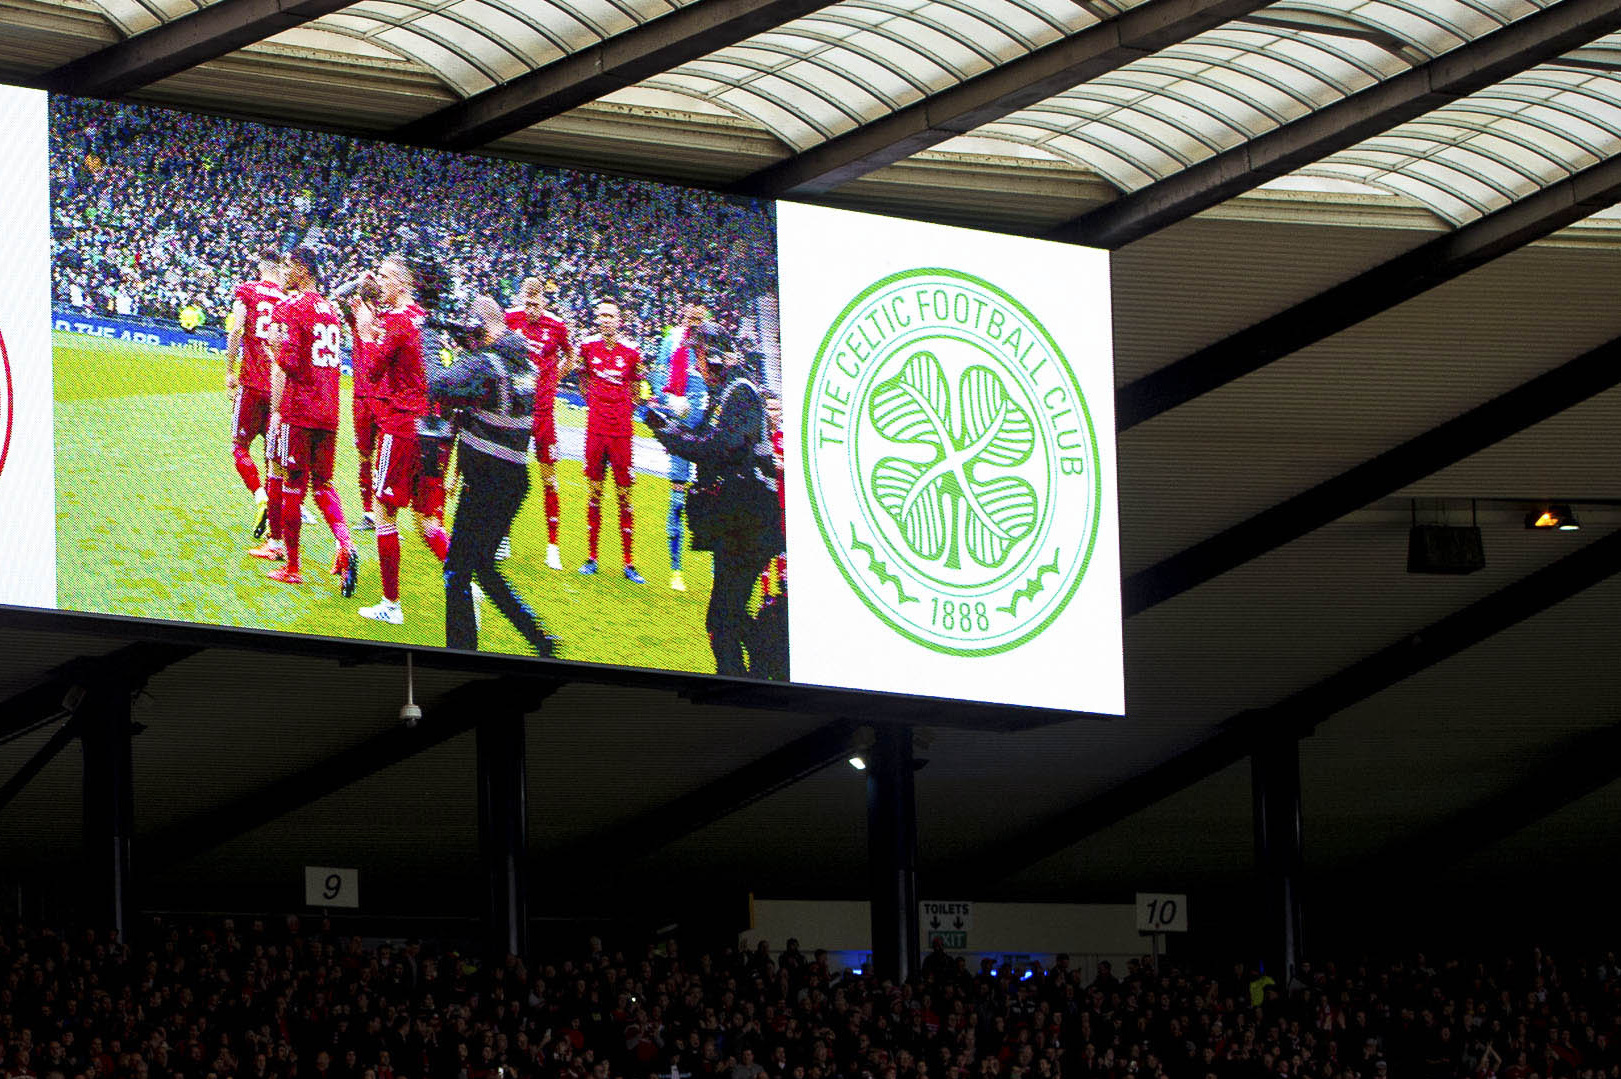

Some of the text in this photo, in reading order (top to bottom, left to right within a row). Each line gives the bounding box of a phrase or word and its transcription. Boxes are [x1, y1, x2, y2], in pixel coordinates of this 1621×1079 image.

[818, 289, 1085, 477] THE CELTIC FOOTBALL CLUB
[929, 597, 991, 634] 1888
[322, 873, 343, 900] 9
[924, 903, 970, 915] TOILETS
[1145, 898, 1178, 925] 10
